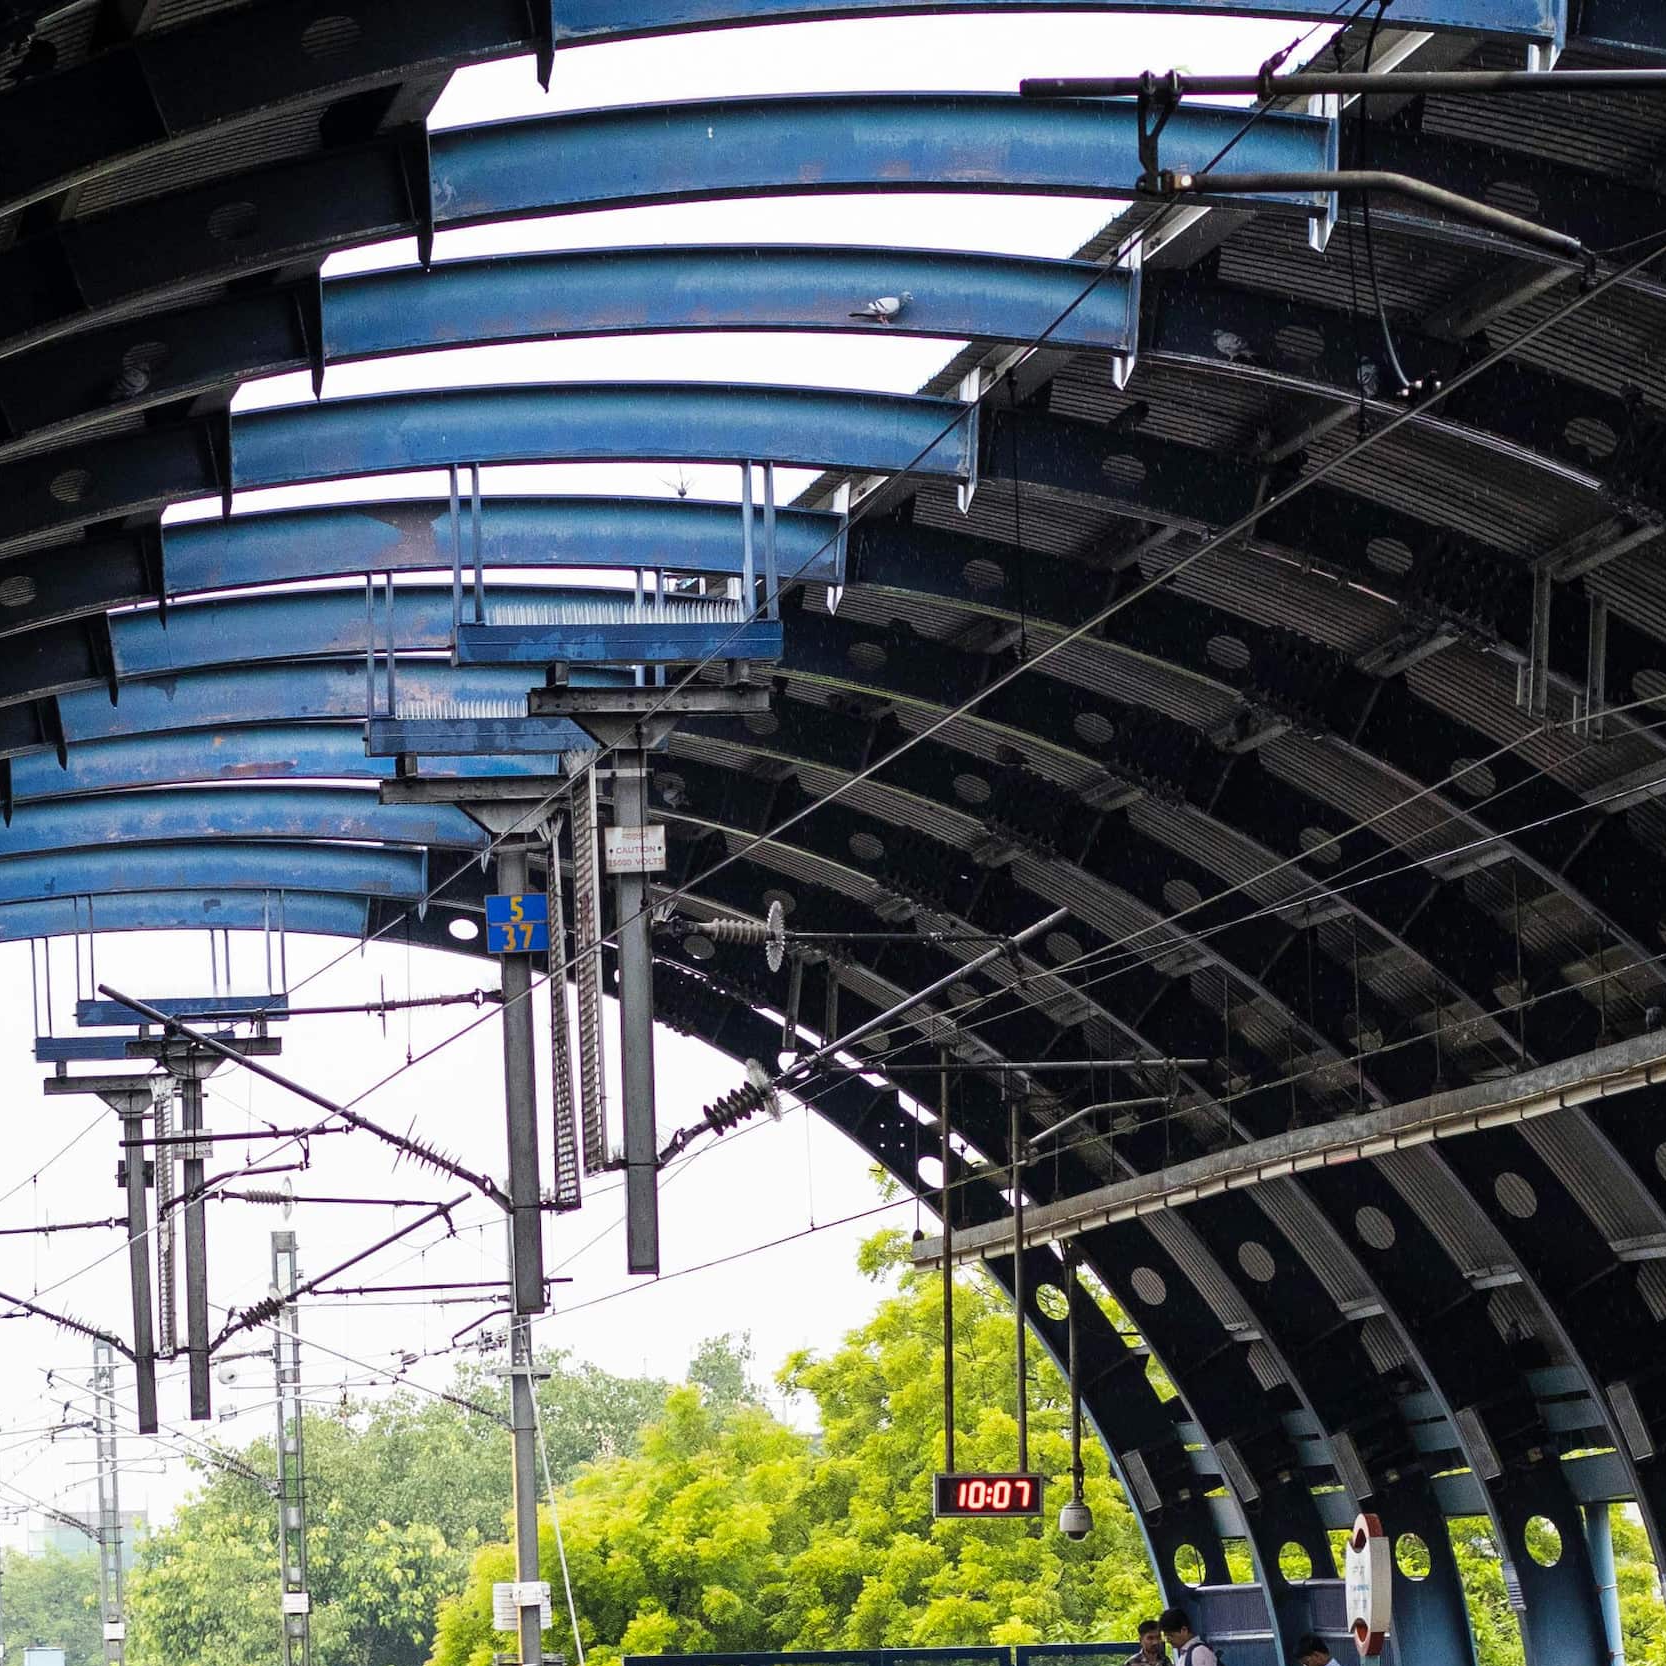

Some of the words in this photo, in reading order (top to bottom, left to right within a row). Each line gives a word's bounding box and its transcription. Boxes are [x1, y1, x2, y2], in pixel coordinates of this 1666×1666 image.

[616, 846, 656, 855] CAUTON
[510, 897, 523, 922] 5
[501, 924, 533, 951] 37
[958, 1480, 1031, 1510] 10:07
